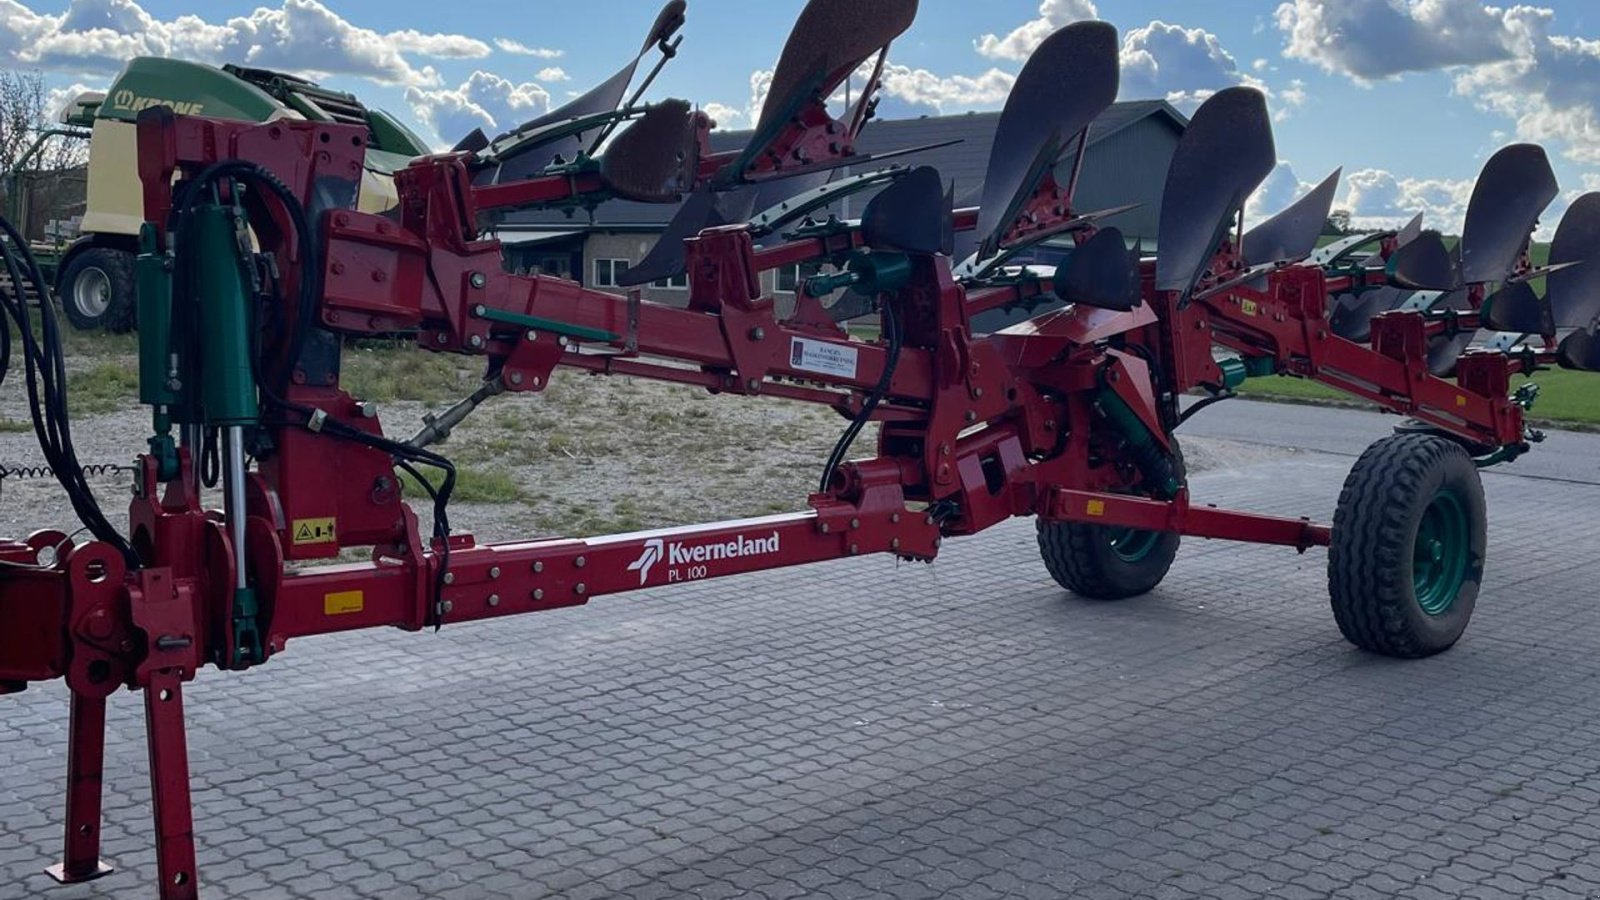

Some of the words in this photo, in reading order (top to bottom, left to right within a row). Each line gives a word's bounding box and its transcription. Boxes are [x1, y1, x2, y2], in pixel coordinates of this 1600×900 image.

[668, 531, 780, 565] Kverneland
[668, 570, 683, 582] PL
[687, 566, 707, 580] 100
